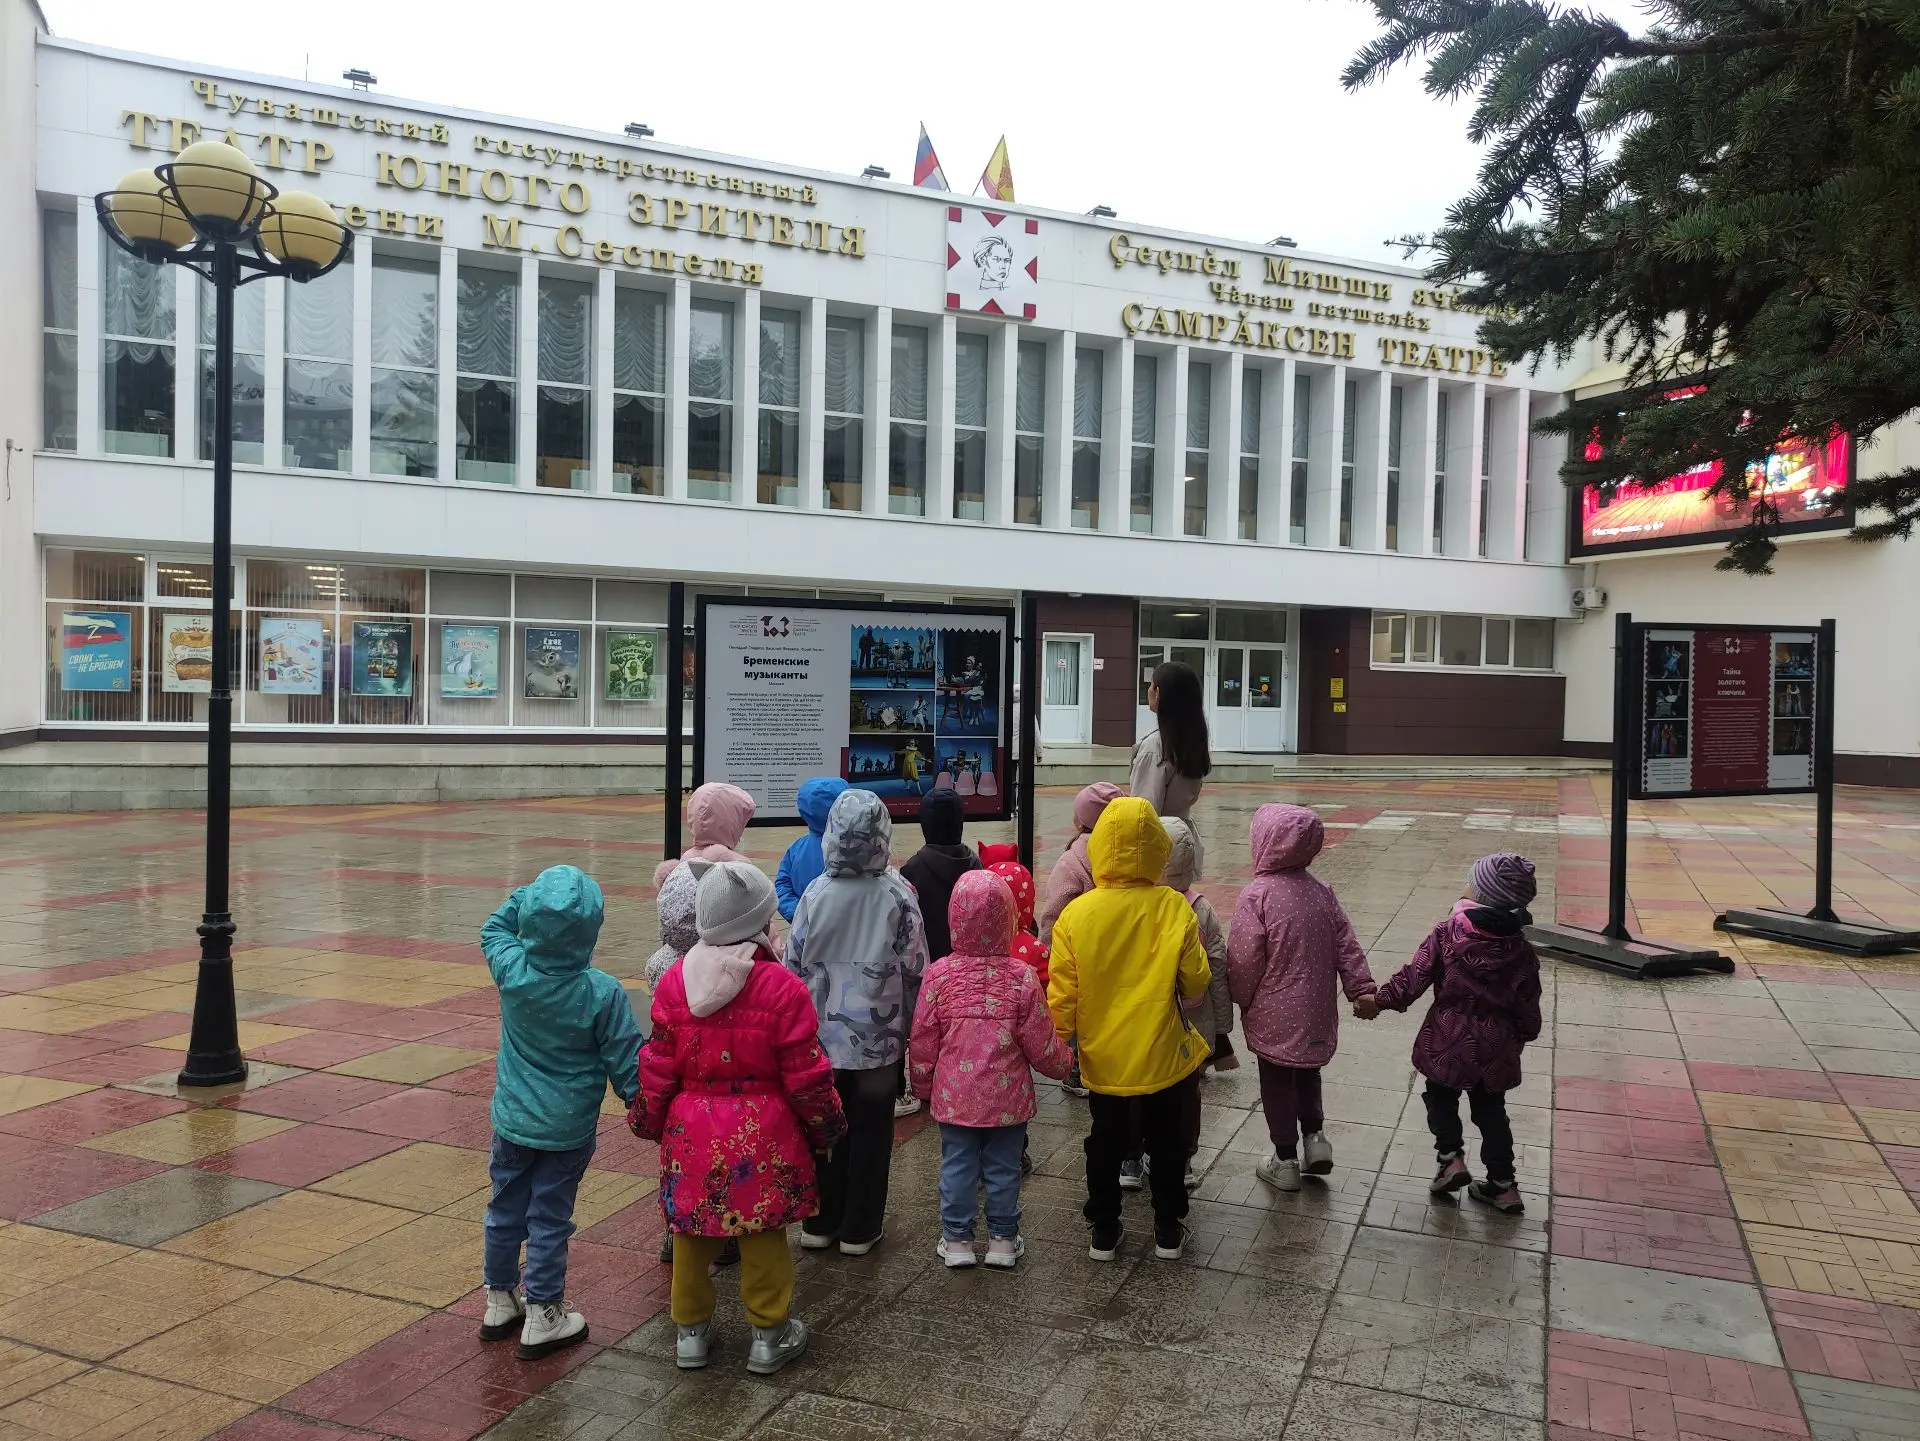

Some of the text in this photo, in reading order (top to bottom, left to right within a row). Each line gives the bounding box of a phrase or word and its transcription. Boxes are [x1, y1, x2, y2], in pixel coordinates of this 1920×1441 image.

[190, 79, 819, 205] Чувашский государственный
[376, 151, 591, 214] ЮНОГО
[628, 190, 867, 259] ЗРИТЕЛЯ
[1264, 256, 1393, 301] Мишши
[68, 653, 94, 665] СВОИХ
[743, 656, 810, 667] Бременские
[78, 660, 124, 673] НЕ БРОСАЕМ
[1722, 667, 1741, 676] Тайна
[744, 671, 808, 681] музыканты
